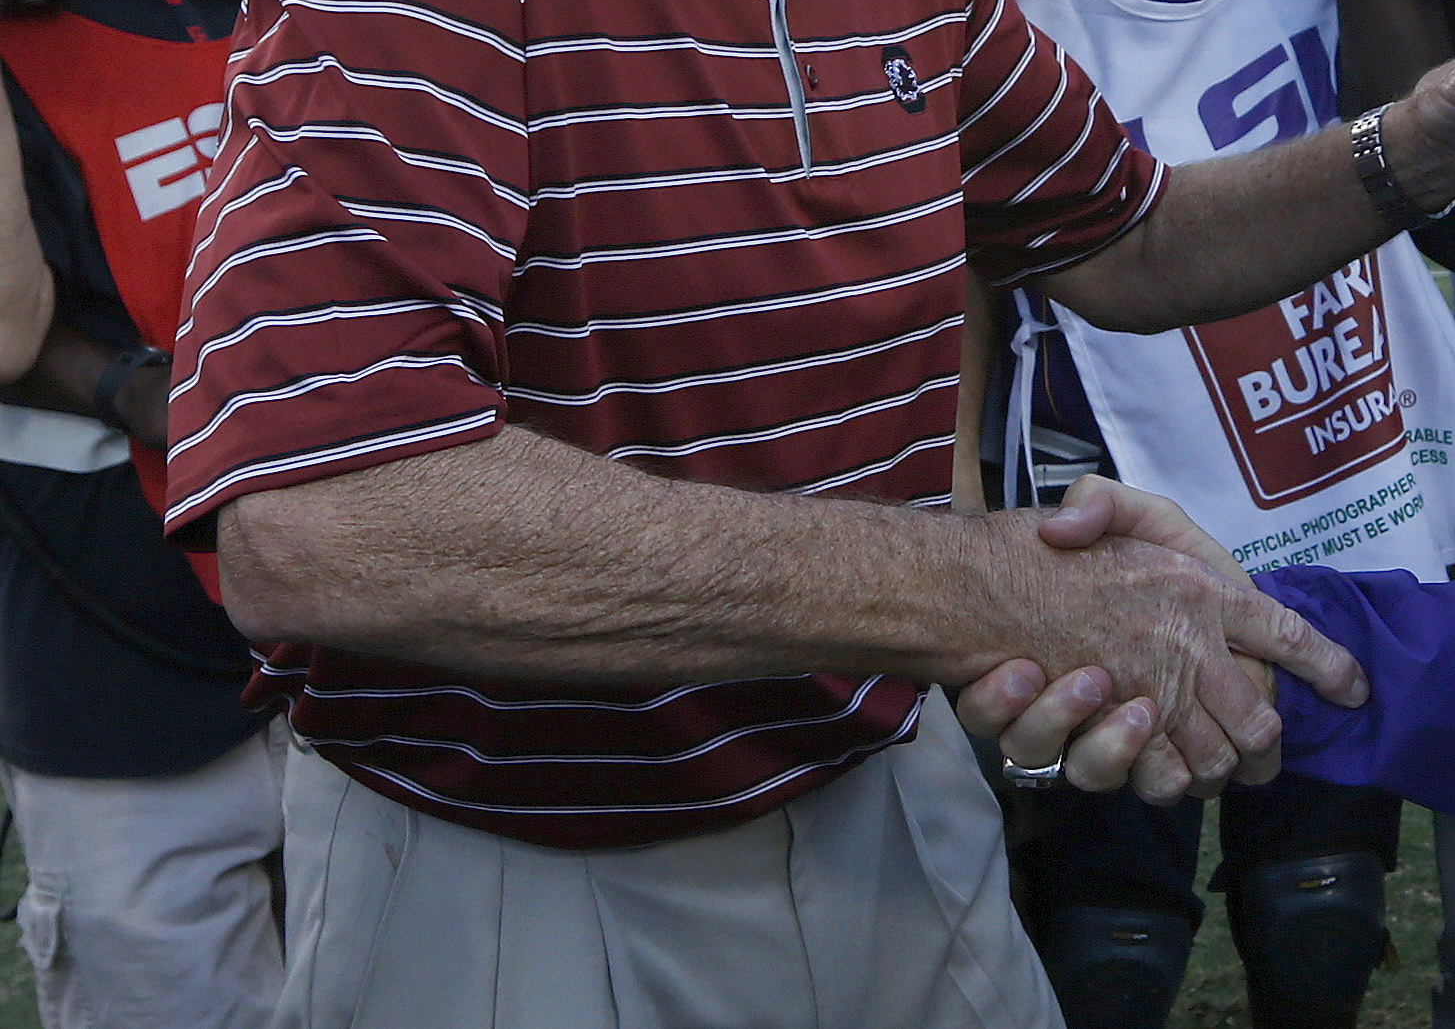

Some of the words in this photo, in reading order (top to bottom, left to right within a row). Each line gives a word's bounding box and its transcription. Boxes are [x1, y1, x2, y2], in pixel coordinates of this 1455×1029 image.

[1232, 528, 1301, 563] OFFICIAL
[1301, 472, 1416, 539] PHOTOGRAPHER
[1284, 544, 1320, 567] VEST
[1322, 528, 1362, 557] MUST
[1364, 516, 1389, 539] BE
